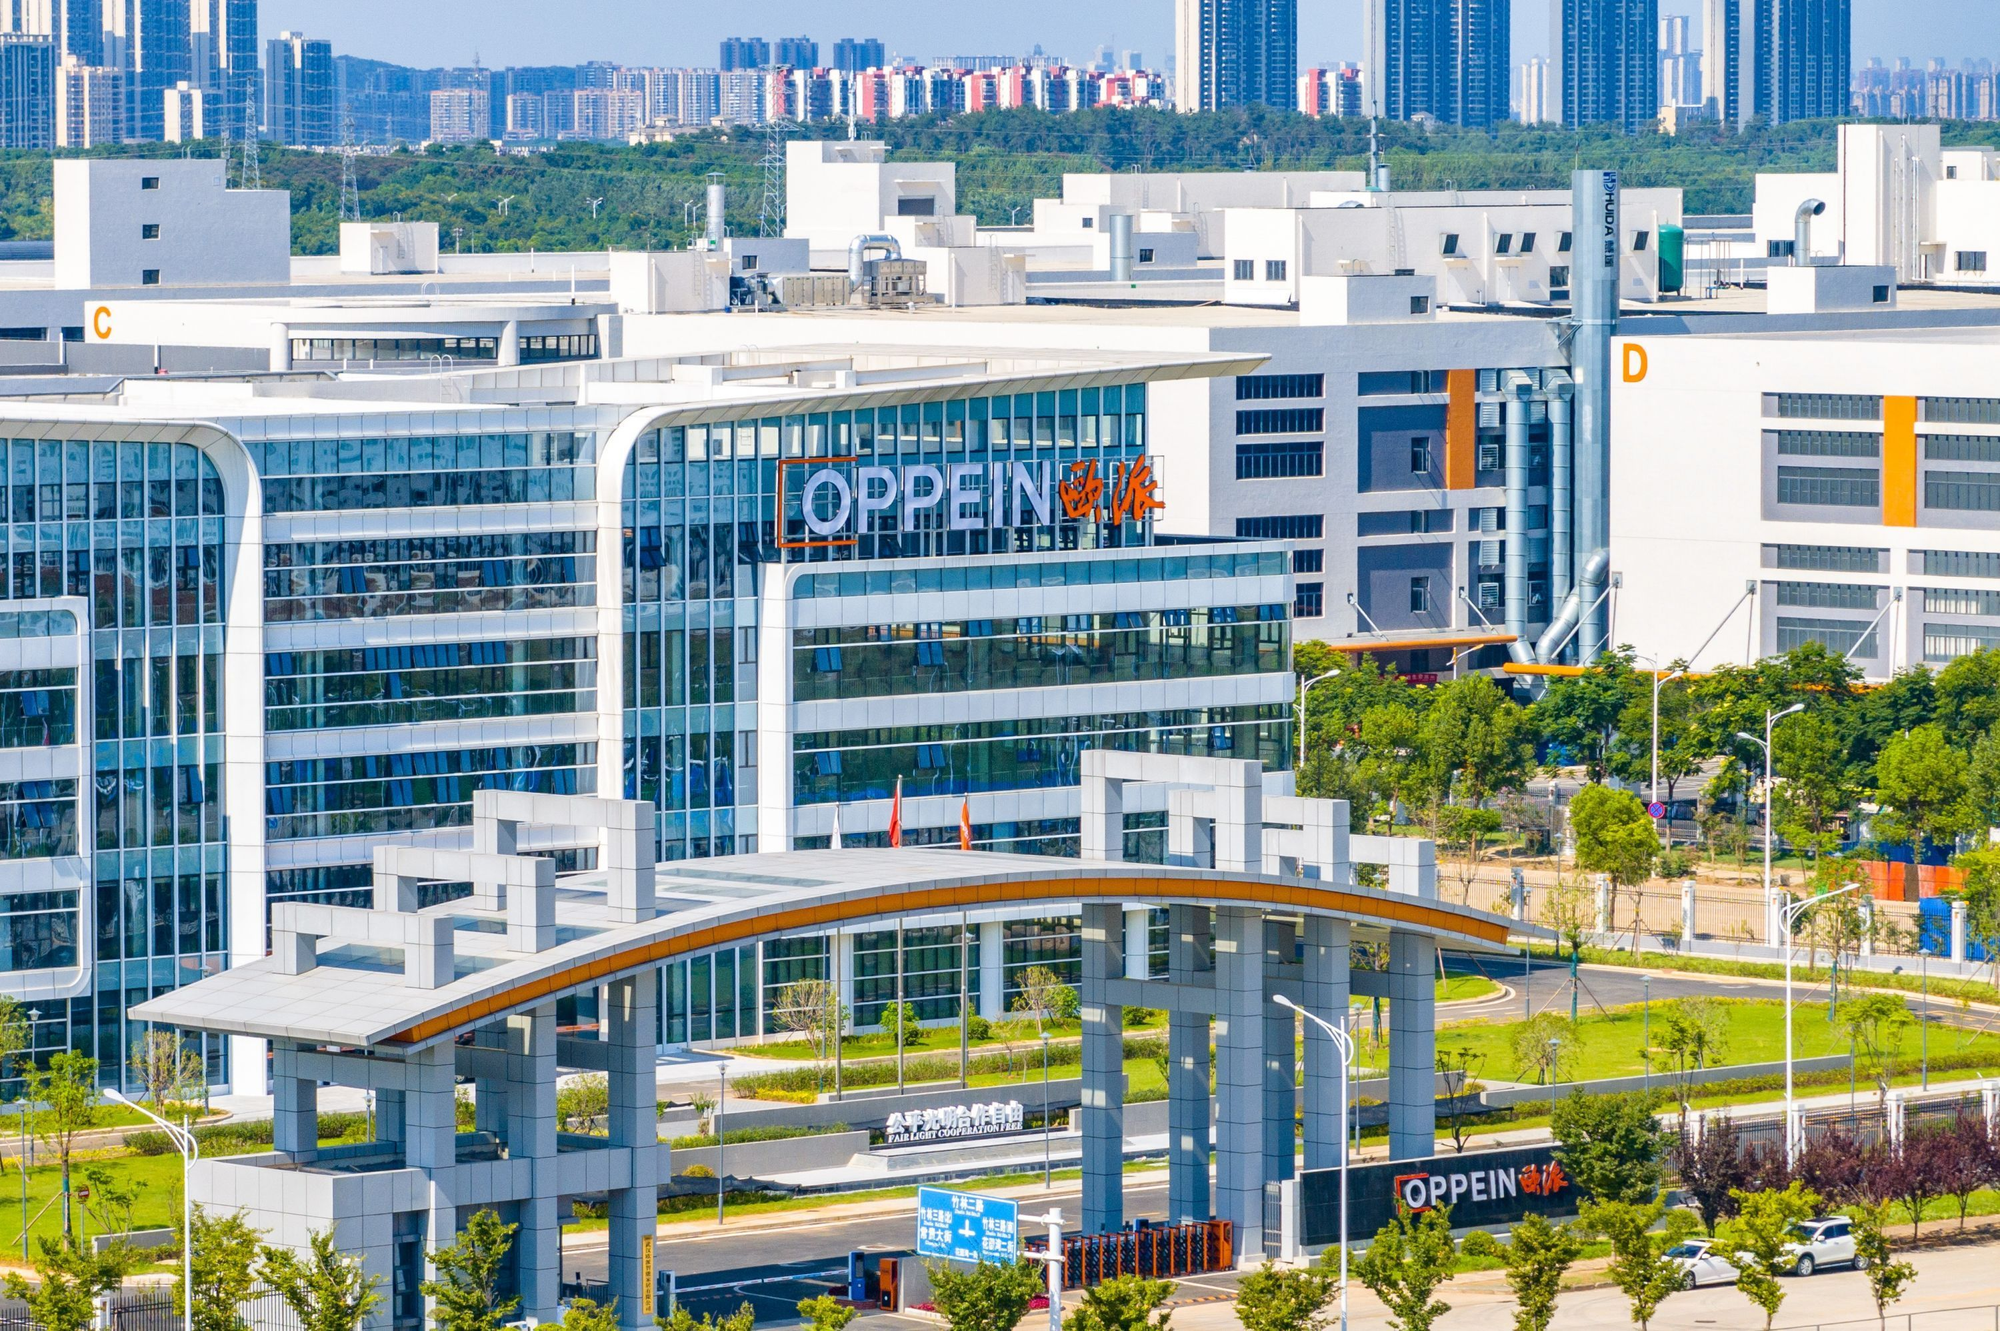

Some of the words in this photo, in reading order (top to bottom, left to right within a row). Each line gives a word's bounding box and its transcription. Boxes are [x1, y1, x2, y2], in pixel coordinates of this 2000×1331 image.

[1604, 192, 1615, 236] HUIDA
[93, 305, 112, 340] C
[1622, 343, 1648, 383] D
[801, 460, 1051, 536] OPPEIN
[885, 1100, 1024, 1134] 公平光明合作自由
[888, 1133, 910, 1143] FAIR
[910, 1130, 938, 1141] LIGHT
[938, 1123, 1000, 1138] COOPERATION
[1000, 1121, 1023, 1132] FREE
[1404, 1168, 1517, 1209] OPPEIN
